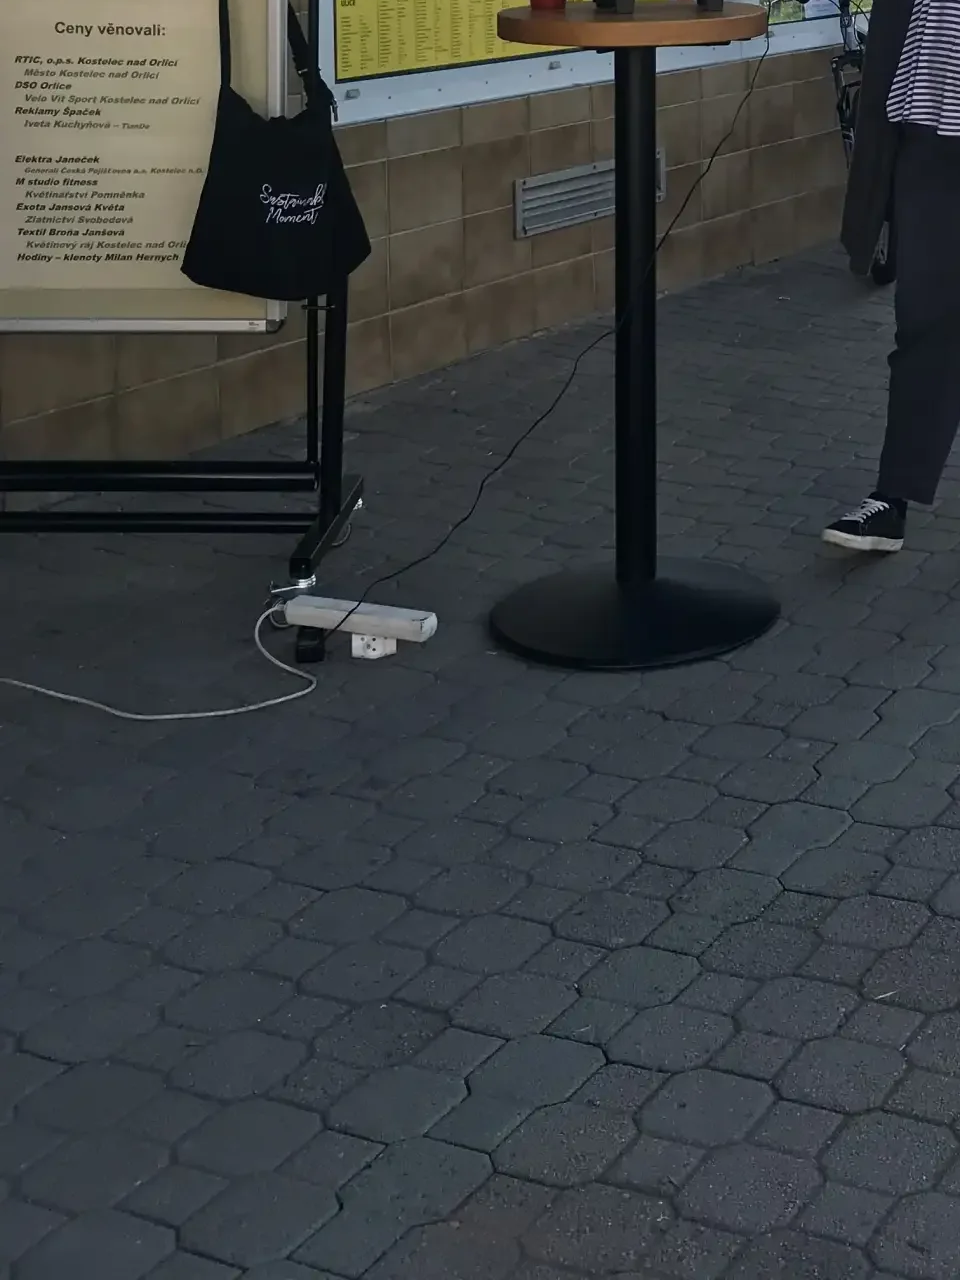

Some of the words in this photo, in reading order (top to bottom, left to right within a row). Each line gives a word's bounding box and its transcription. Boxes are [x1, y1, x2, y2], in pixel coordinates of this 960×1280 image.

[54, 22, 94, 37] Ceny
[97, 22, 166, 36] věnovali:
[14, 56, 43, 65] RTIC,
[77, 57, 124, 66] Kostelec
[126, 58, 146, 66] nad
[24, 69, 57, 78] Město
[59, 69, 105, 78] Kostelec
[108, 70, 128, 79] nad
[15, 81, 38, 90] DSO
[40, 81, 73, 91] Orlice
[25, 94, 48, 103] Velo
[68, 95, 97, 106] Sport
[100, 96, 146, 105] Kostelec
[148, 96, 168, 105] nad
[15, 107, 60, 118] Reklamy
[63, 106, 102, 117] Špaček
[24, 120, 51, 129] Iveta
[15, 155, 53, 163] Elektra
[55, 155, 101, 164] Janeček
[150, 167, 187, 175] Kostelec
[15, 178, 26, 186] M
[28, 178, 60, 186] studio
[62, 177, 99, 186] fitness
[91, 190, 146, 200] Pomněnka
[16, 203, 46, 211] Exota
[94, 203, 125, 212] Květa
[78, 215, 134, 224] Svobodová
[265, 205, 323, 225] Moment
[17, 228, 47, 236] Textil
[82, 228, 125, 237] Janšová
[96, 241, 143, 249] Kostelec
[145, 241, 165, 249] nad
[168, 240, 188, 249] Orli
[16, 253, 53, 263] Hodiny
[63, 253, 103, 263] klenoty
[104, 254, 133, 262] Milan
[135, 254, 179, 263] Hernych
